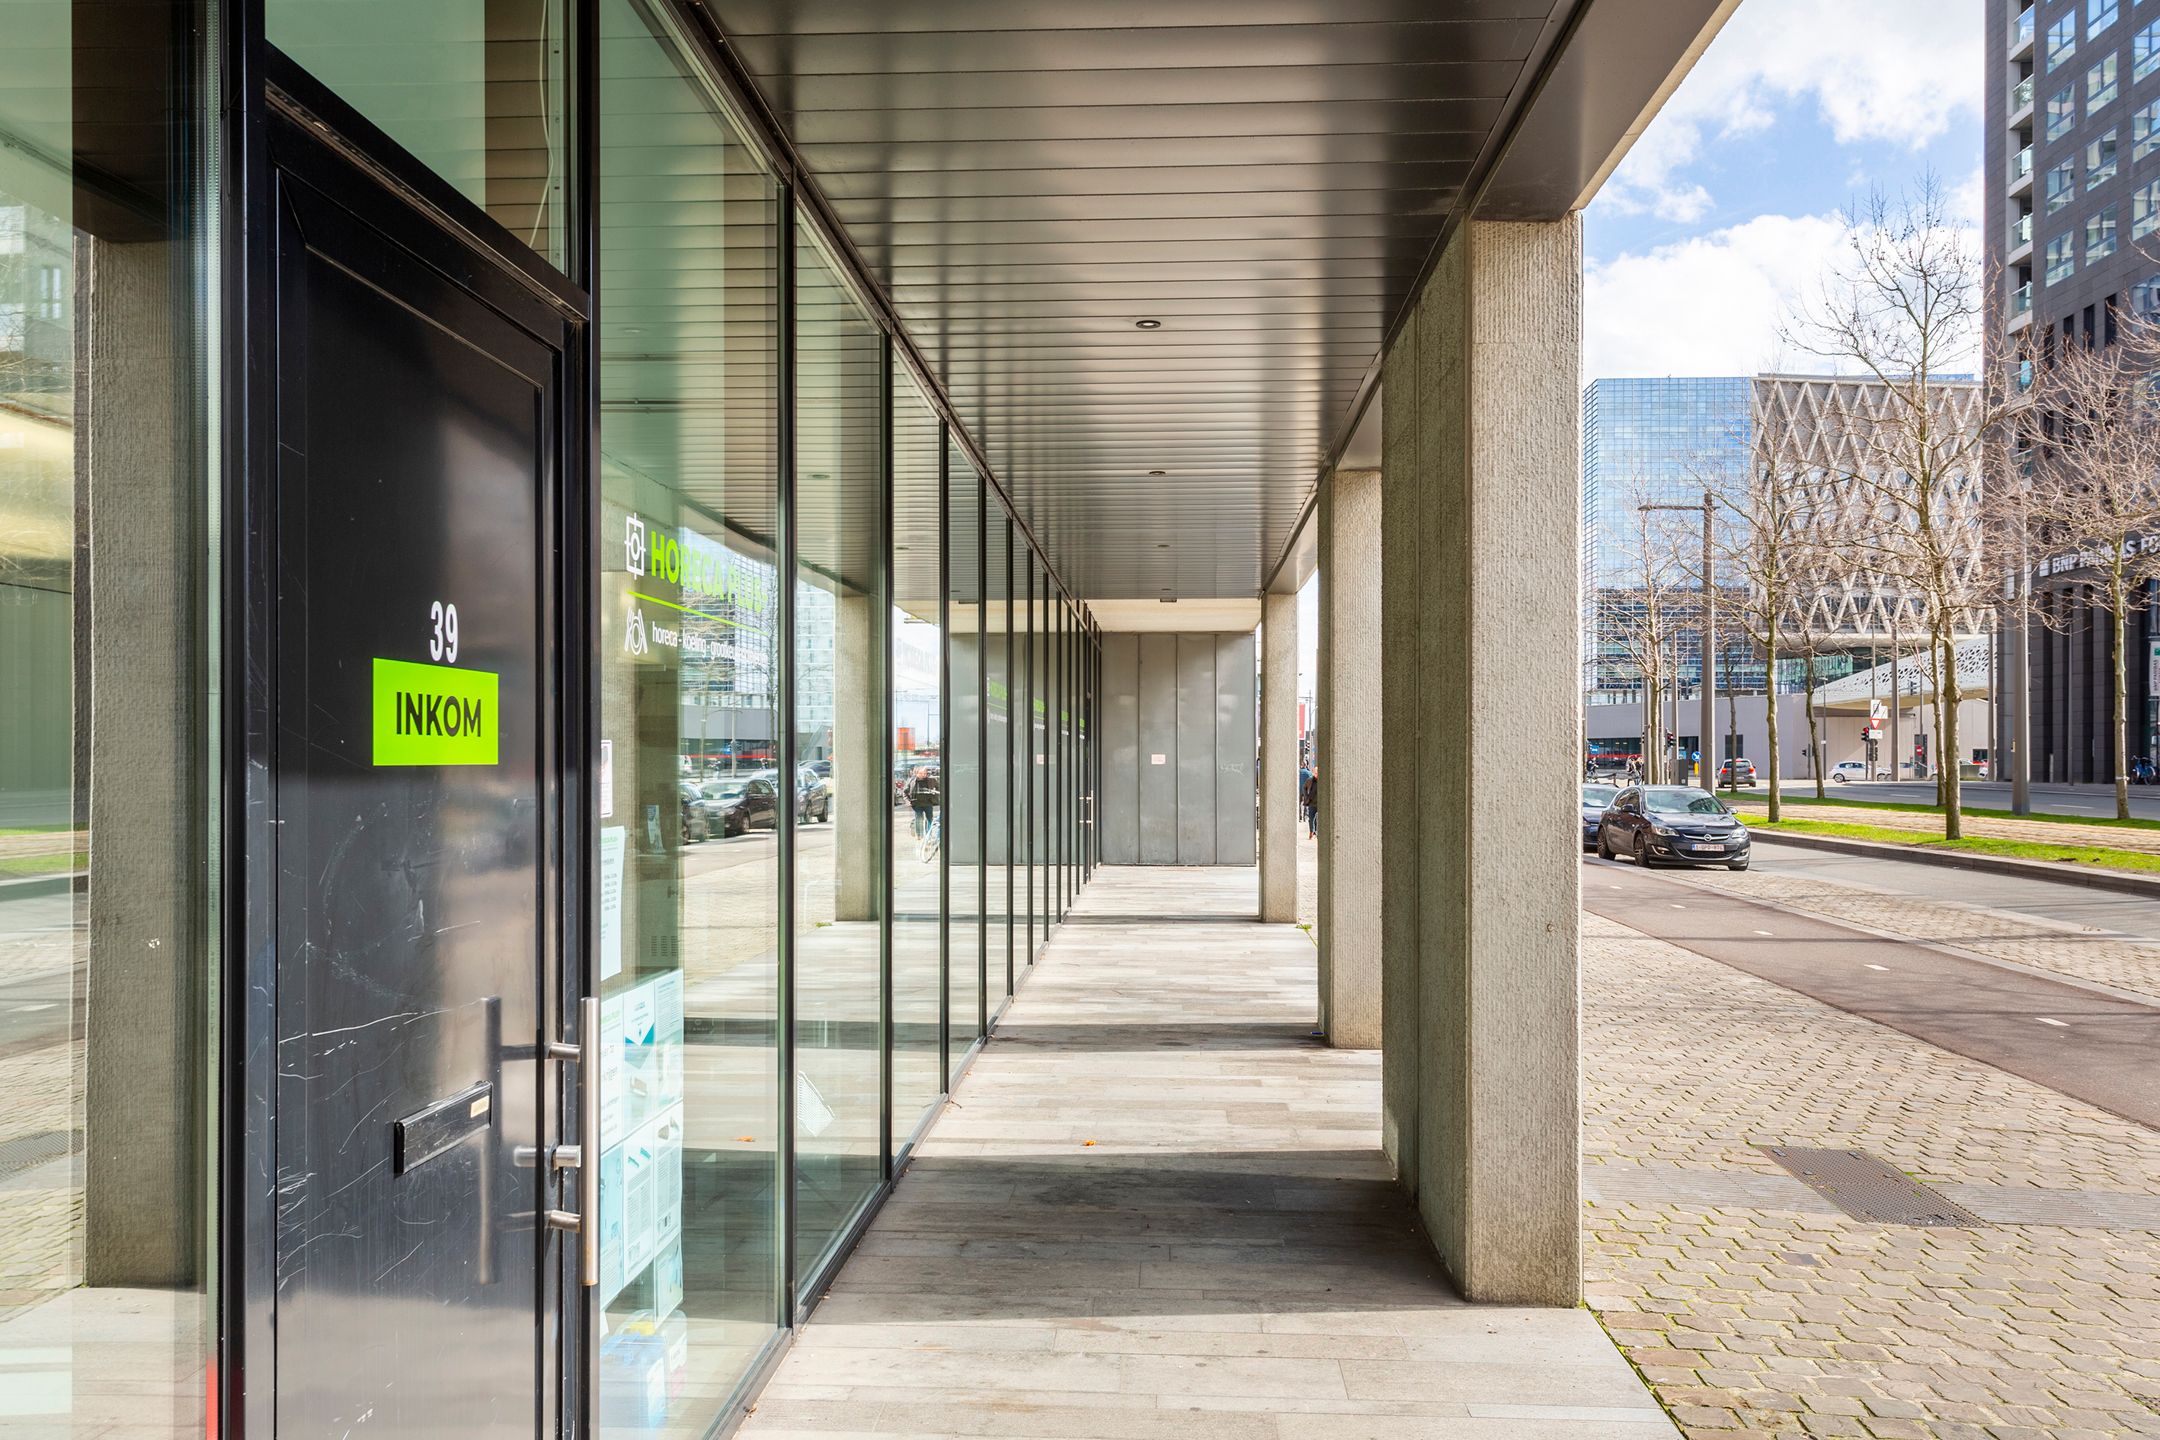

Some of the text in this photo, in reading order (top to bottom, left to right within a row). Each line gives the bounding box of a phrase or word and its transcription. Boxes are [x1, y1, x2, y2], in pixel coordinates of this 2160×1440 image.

[651, 531, 725, 601] HORECA
[2052, 554, 2078, 574] BNP
[429, 600, 459, 664] 39
[652, 621, 678, 648] horeca
[396, 691, 482, 738] INKOM
